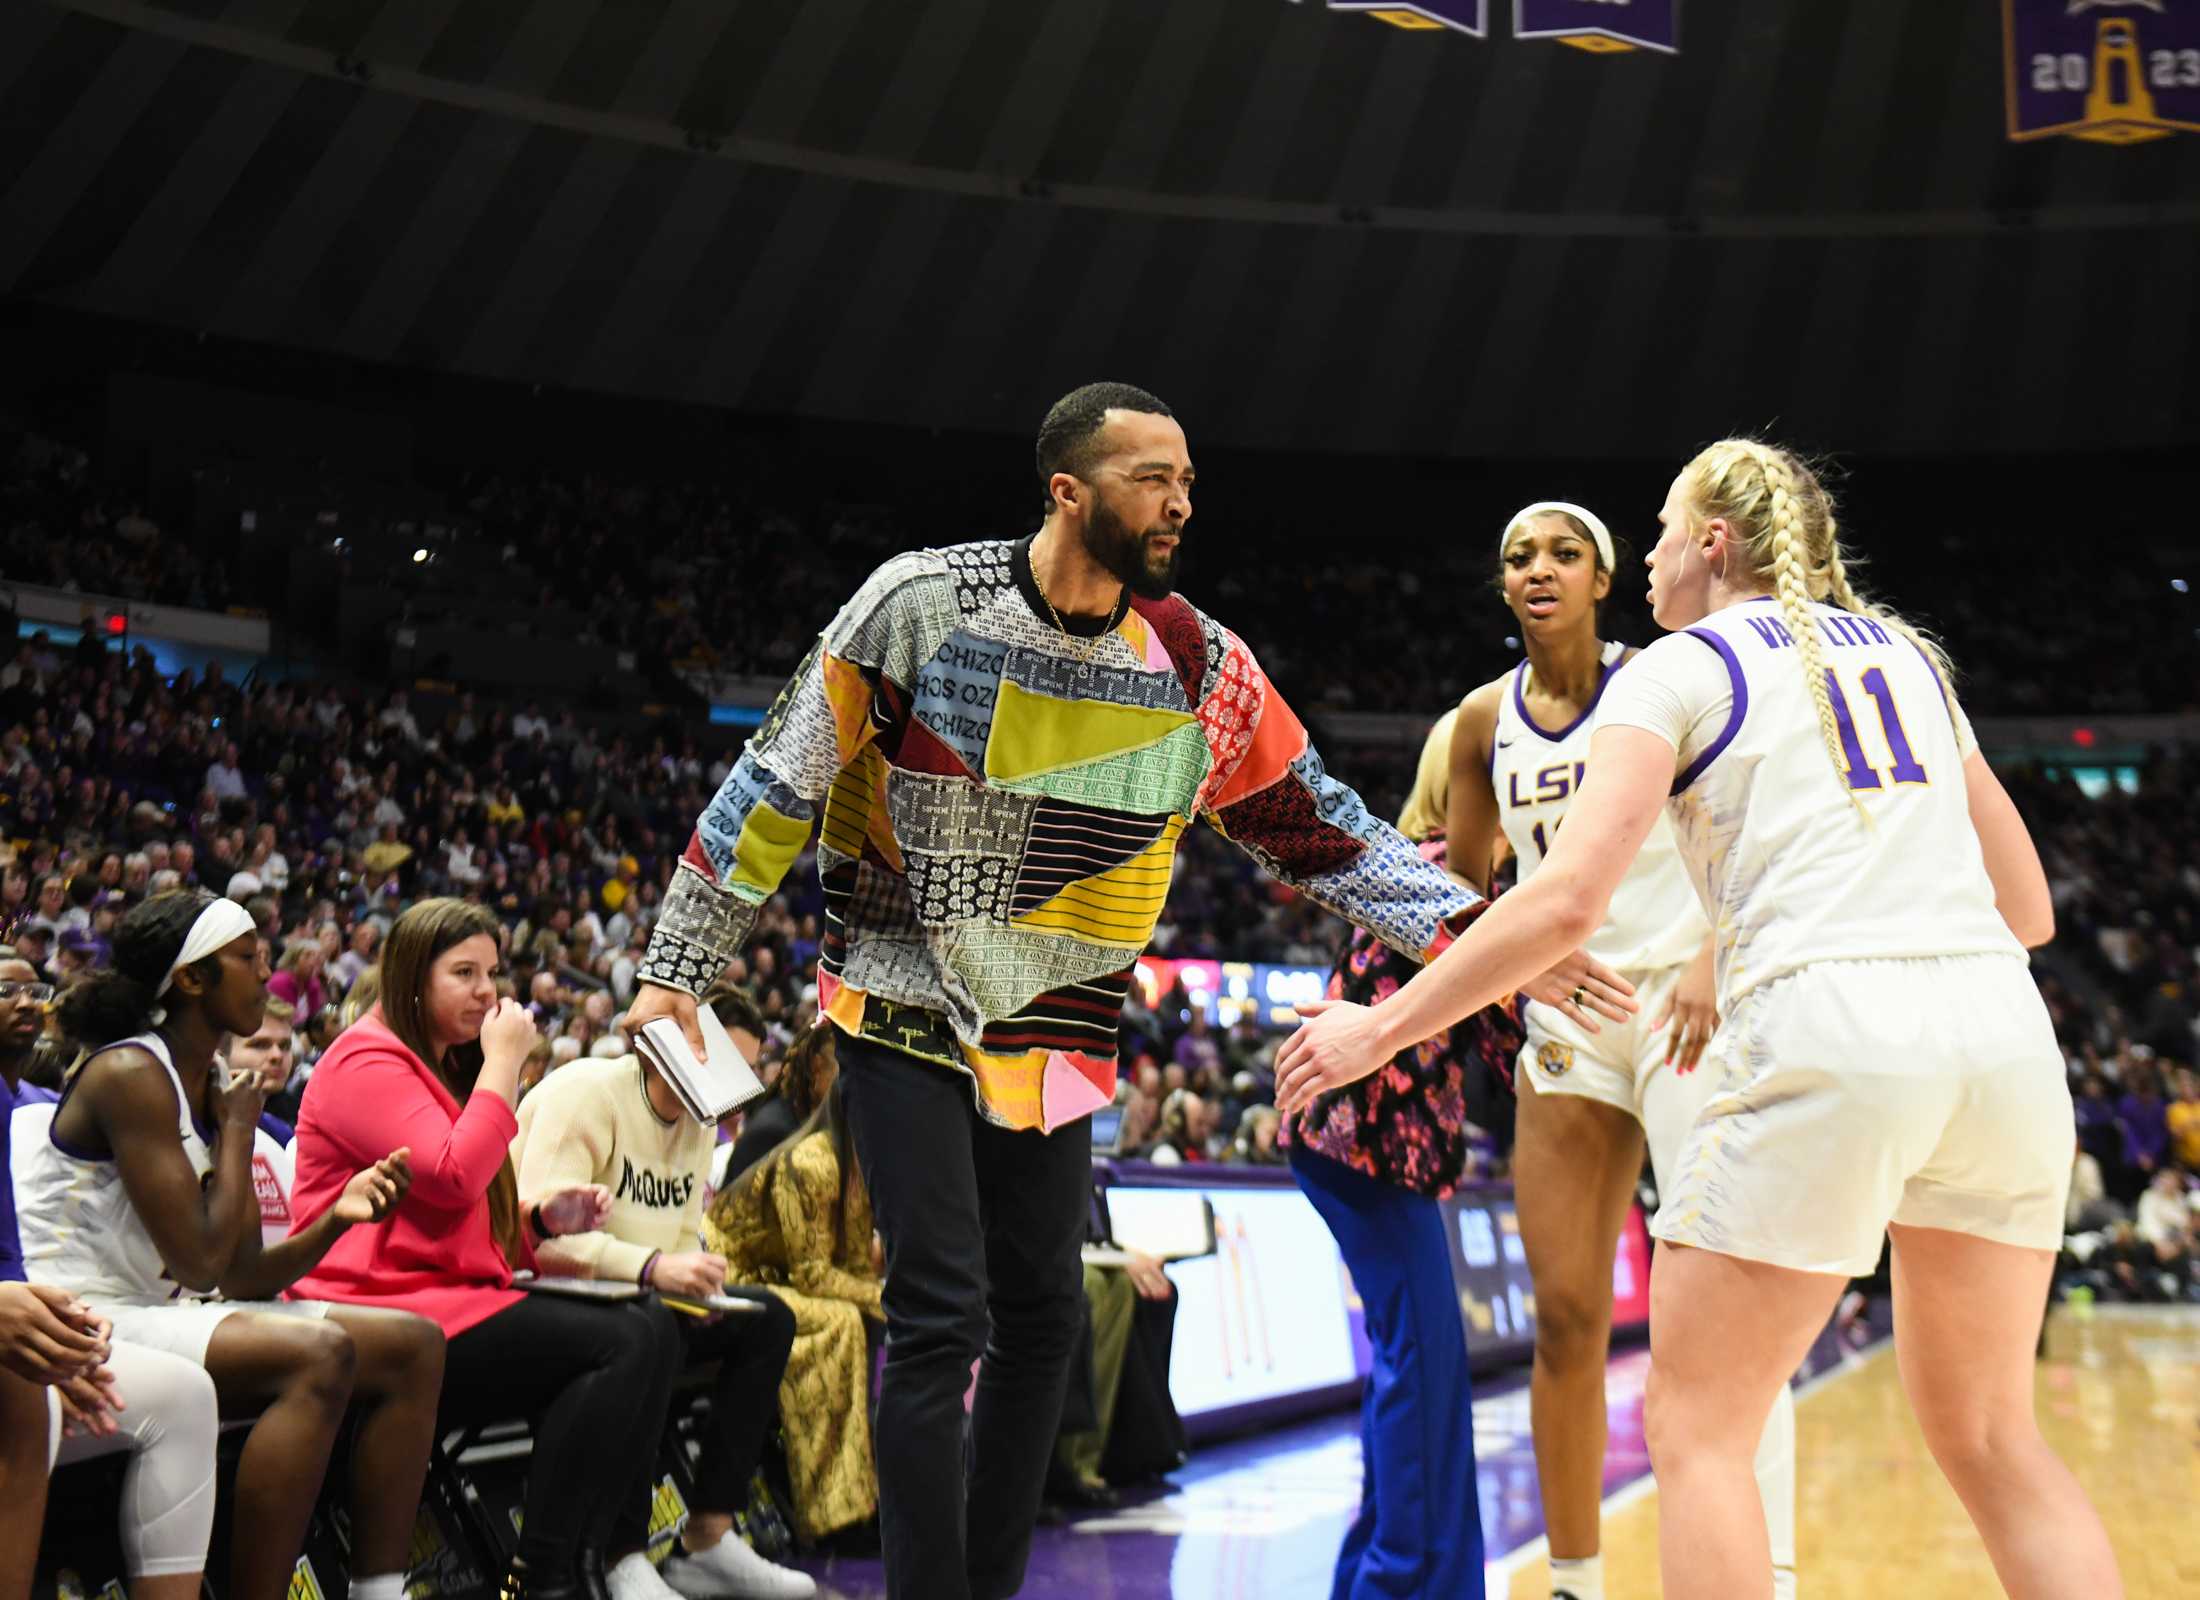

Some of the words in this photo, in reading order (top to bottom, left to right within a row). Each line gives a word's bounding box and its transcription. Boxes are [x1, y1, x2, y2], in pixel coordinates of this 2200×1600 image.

[2031, 53, 2087, 91] 20
[2150, 48, 2200, 87] 23
[1745, 616, 1796, 648] VA
[930, 642, 1003, 675] CHIZO
[1823, 667, 1931, 791] 11
